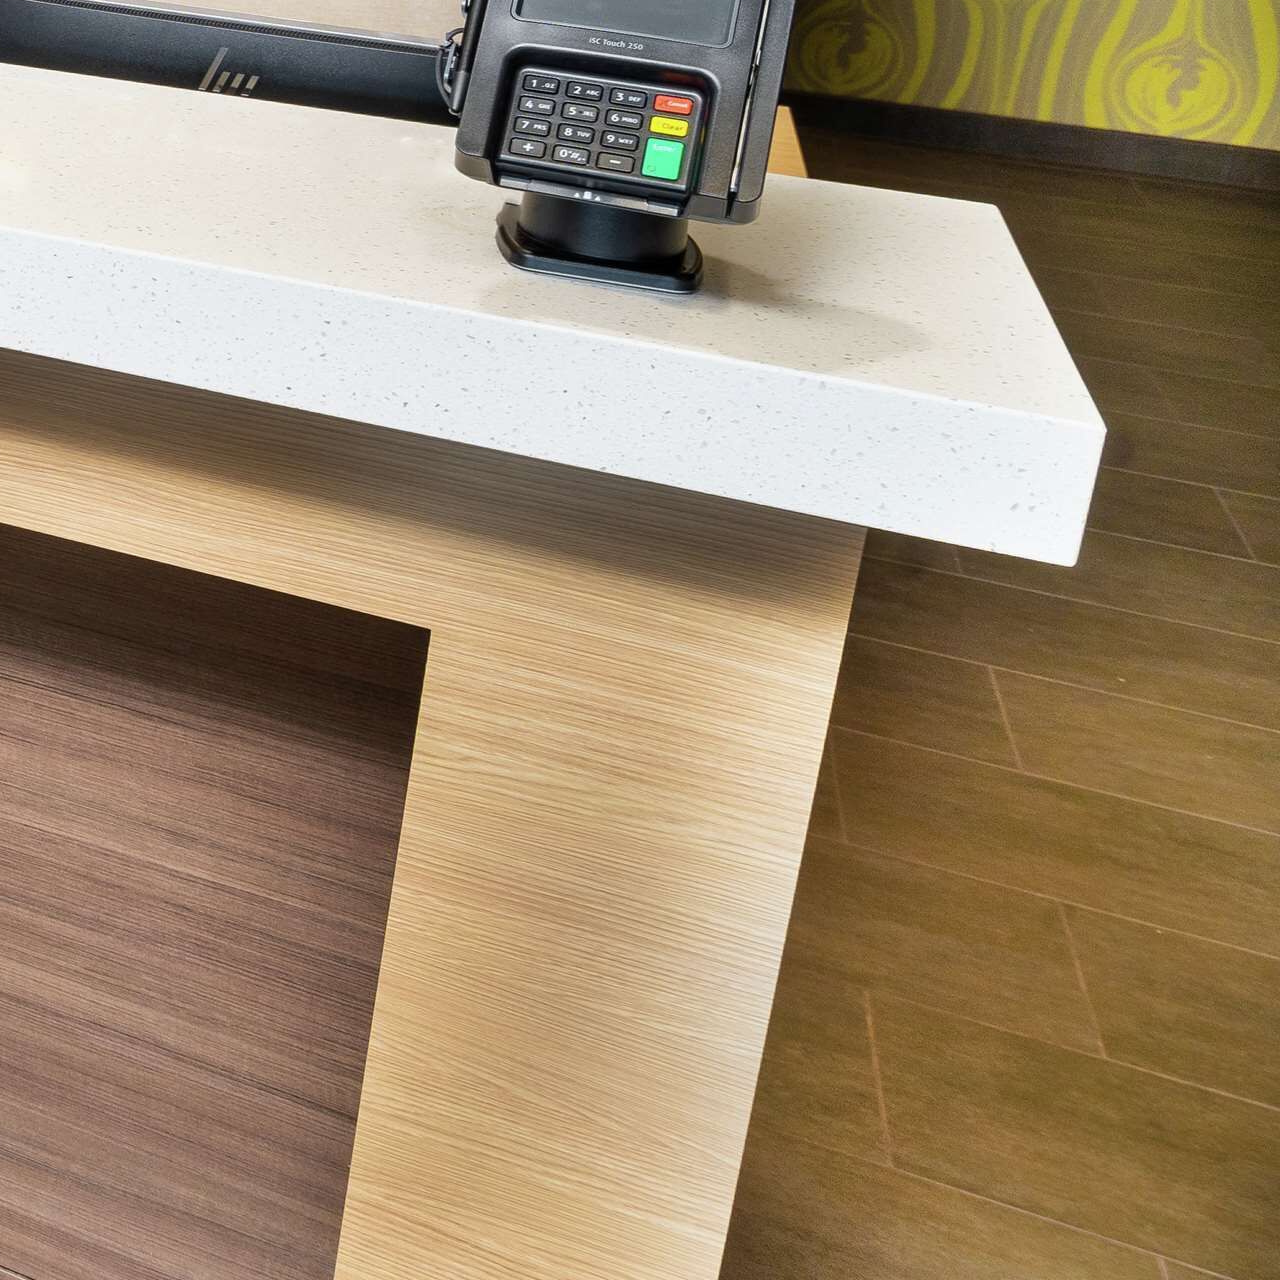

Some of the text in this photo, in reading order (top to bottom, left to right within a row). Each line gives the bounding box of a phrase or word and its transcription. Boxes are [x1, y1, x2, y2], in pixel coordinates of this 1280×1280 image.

[603, 39, 626, 48] Touch
[628, 43, 644, 51] 250
[573, 86, 582, 94] 2
[615, 92, 624, 101] 3
[525, 100, 533, 109] 4
[568, 107, 577, 115] 5
[611, 113, 620, 122] 6
[521, 120, 530, 129] 7
[662, 122, 684, 131] Clear
[564, 127, 573, 136] 8
[606, 134, 615, 143] 9
